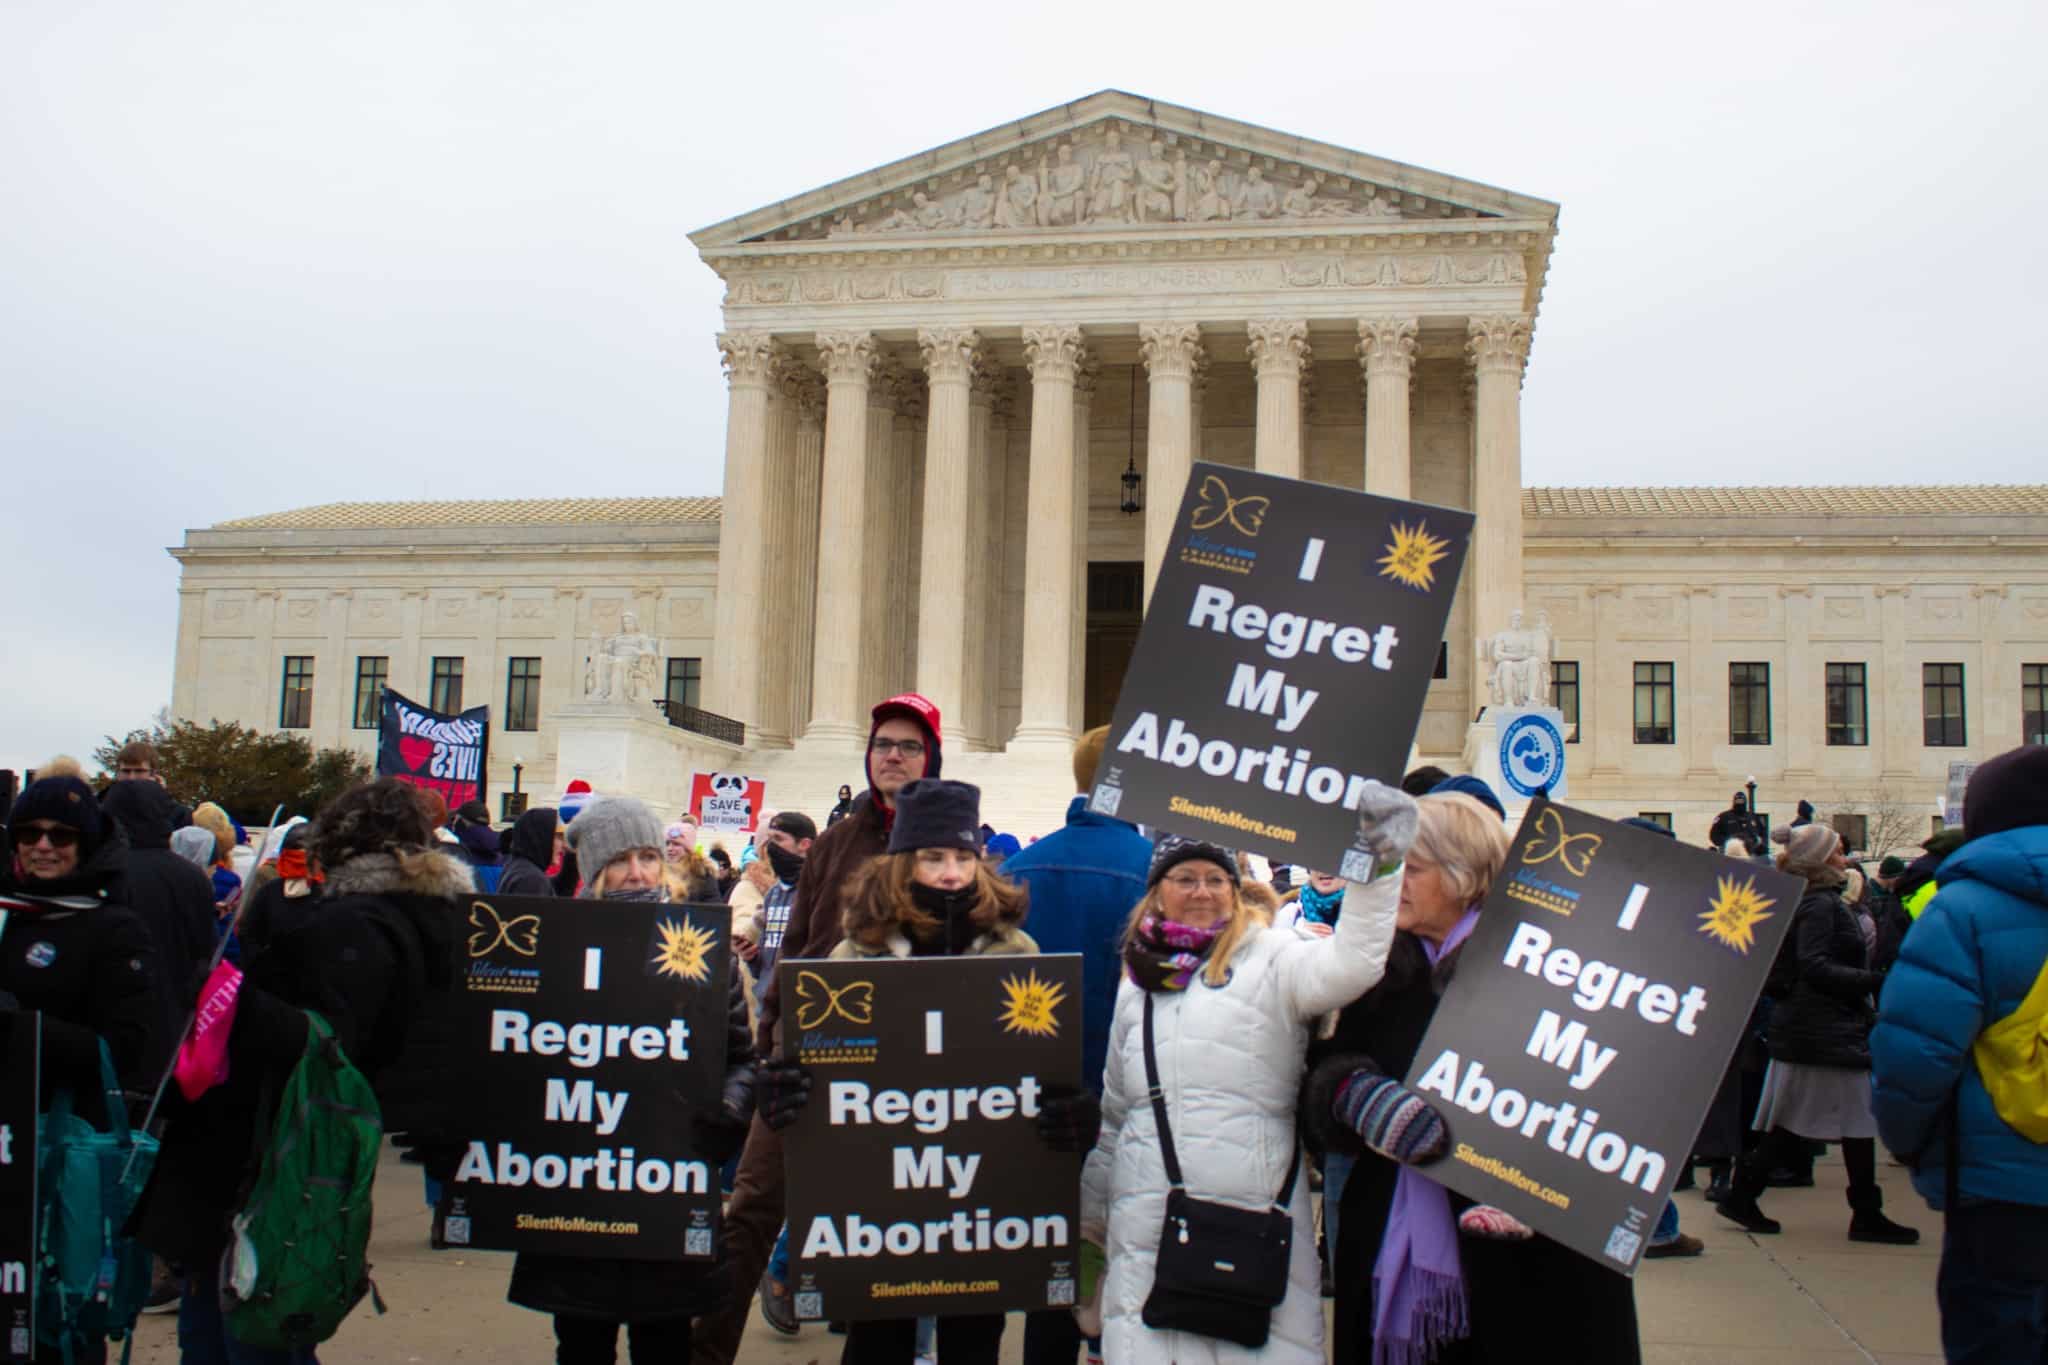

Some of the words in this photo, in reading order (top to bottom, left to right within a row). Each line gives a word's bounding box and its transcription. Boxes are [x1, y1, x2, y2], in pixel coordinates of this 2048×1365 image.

[1137, 268, 1210, 288] UNDER
[1299, 538, 1325, 582] I
[1189, 584, 1399, 670] Regret
[1227, 663, 1319, 733] My
[710, 799, 741, 811] SAVE
[1168, 796, 1297, 843] SilentNoMore.com
[1617, 883, 1650, 931] I
[583, 948, 600, 990] I
[1503, 921, 1708, 1036] Regret
[491, 1010, 690, 1067] Regret
[925, 1011, 942, 1054] I
[1525, 1009, 1619, 1091] My
[545, 1079, 628, 1135] My
[829, 1077, 1041, 1133] Regret
[1418, 1049, 1667, 1194] Abortion
[455, 1142, 708, 1193] Abortion
[893, 1146, 980, 1198] My
[1454, 1143, 1570, 1208] SilentNoMore.com
[516, 1215, 640, 1236] SilentNoMore.com
[801, 1209, 1067, 1258] Abortion
[872, 1281, 1000, 1299] SilentNoMore.com
